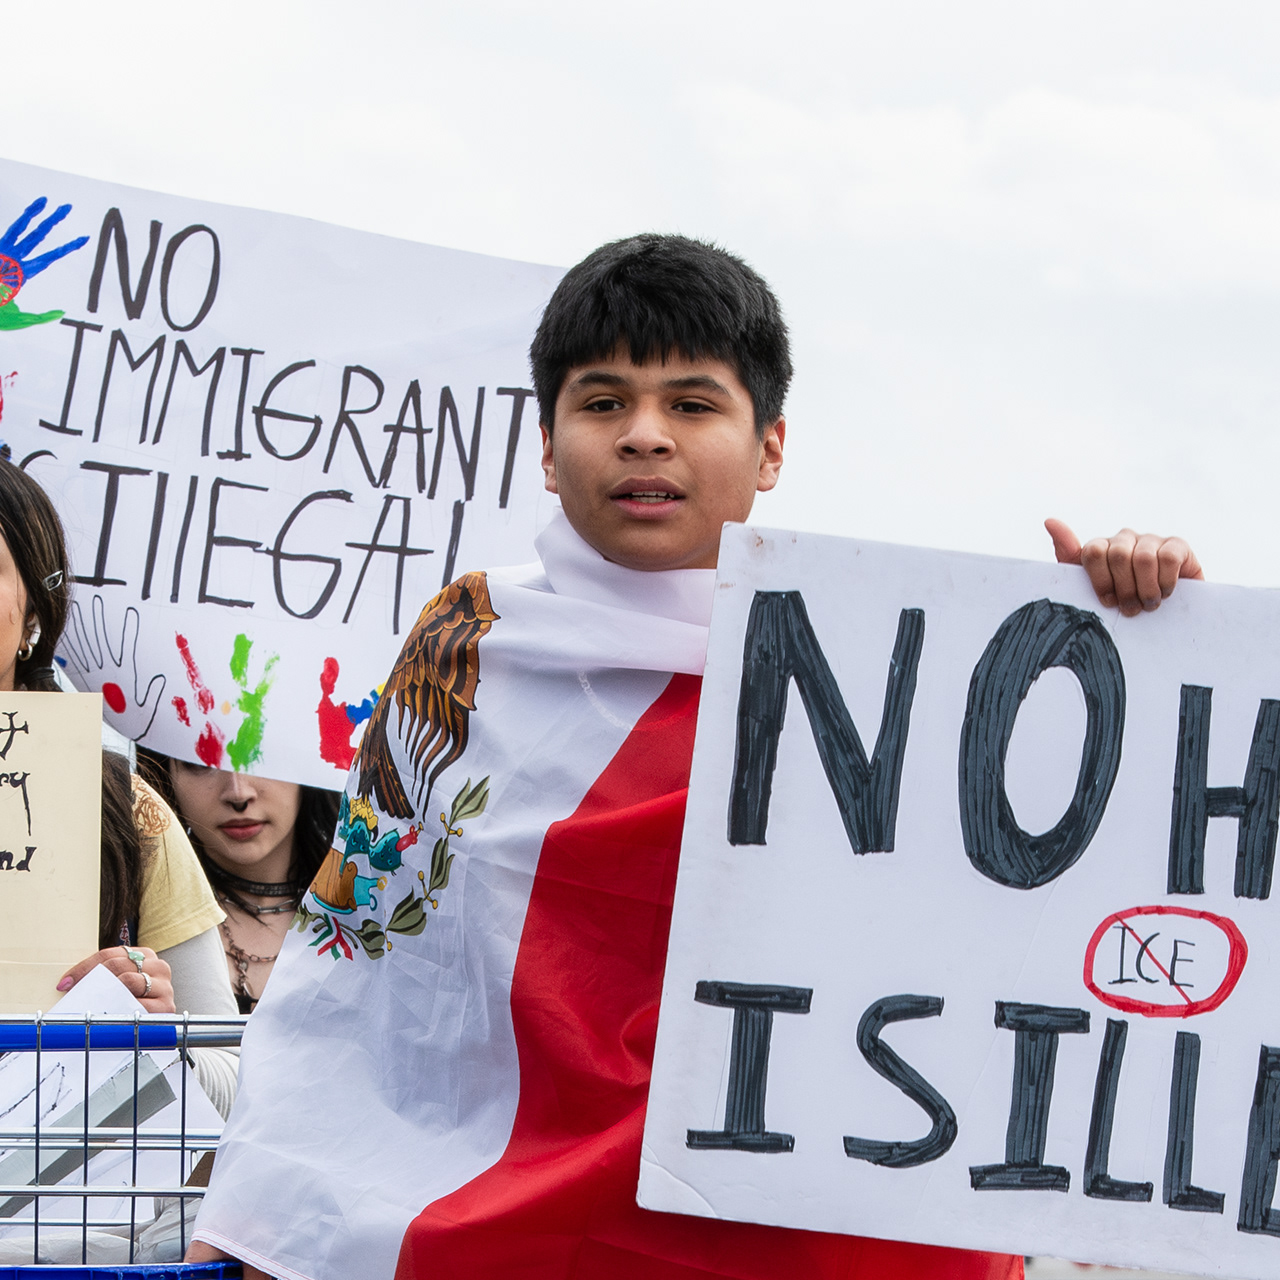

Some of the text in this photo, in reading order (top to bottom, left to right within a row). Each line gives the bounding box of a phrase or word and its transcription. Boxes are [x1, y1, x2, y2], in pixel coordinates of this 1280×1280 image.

[87, 207, 220, 331] NO
[39, 318, 534, 508] IMMIGRANT
[727, 589, 1126, 890] NO
[1108, 925, 1196, 988] ICE
[685, 980, 958, 1169] IS
